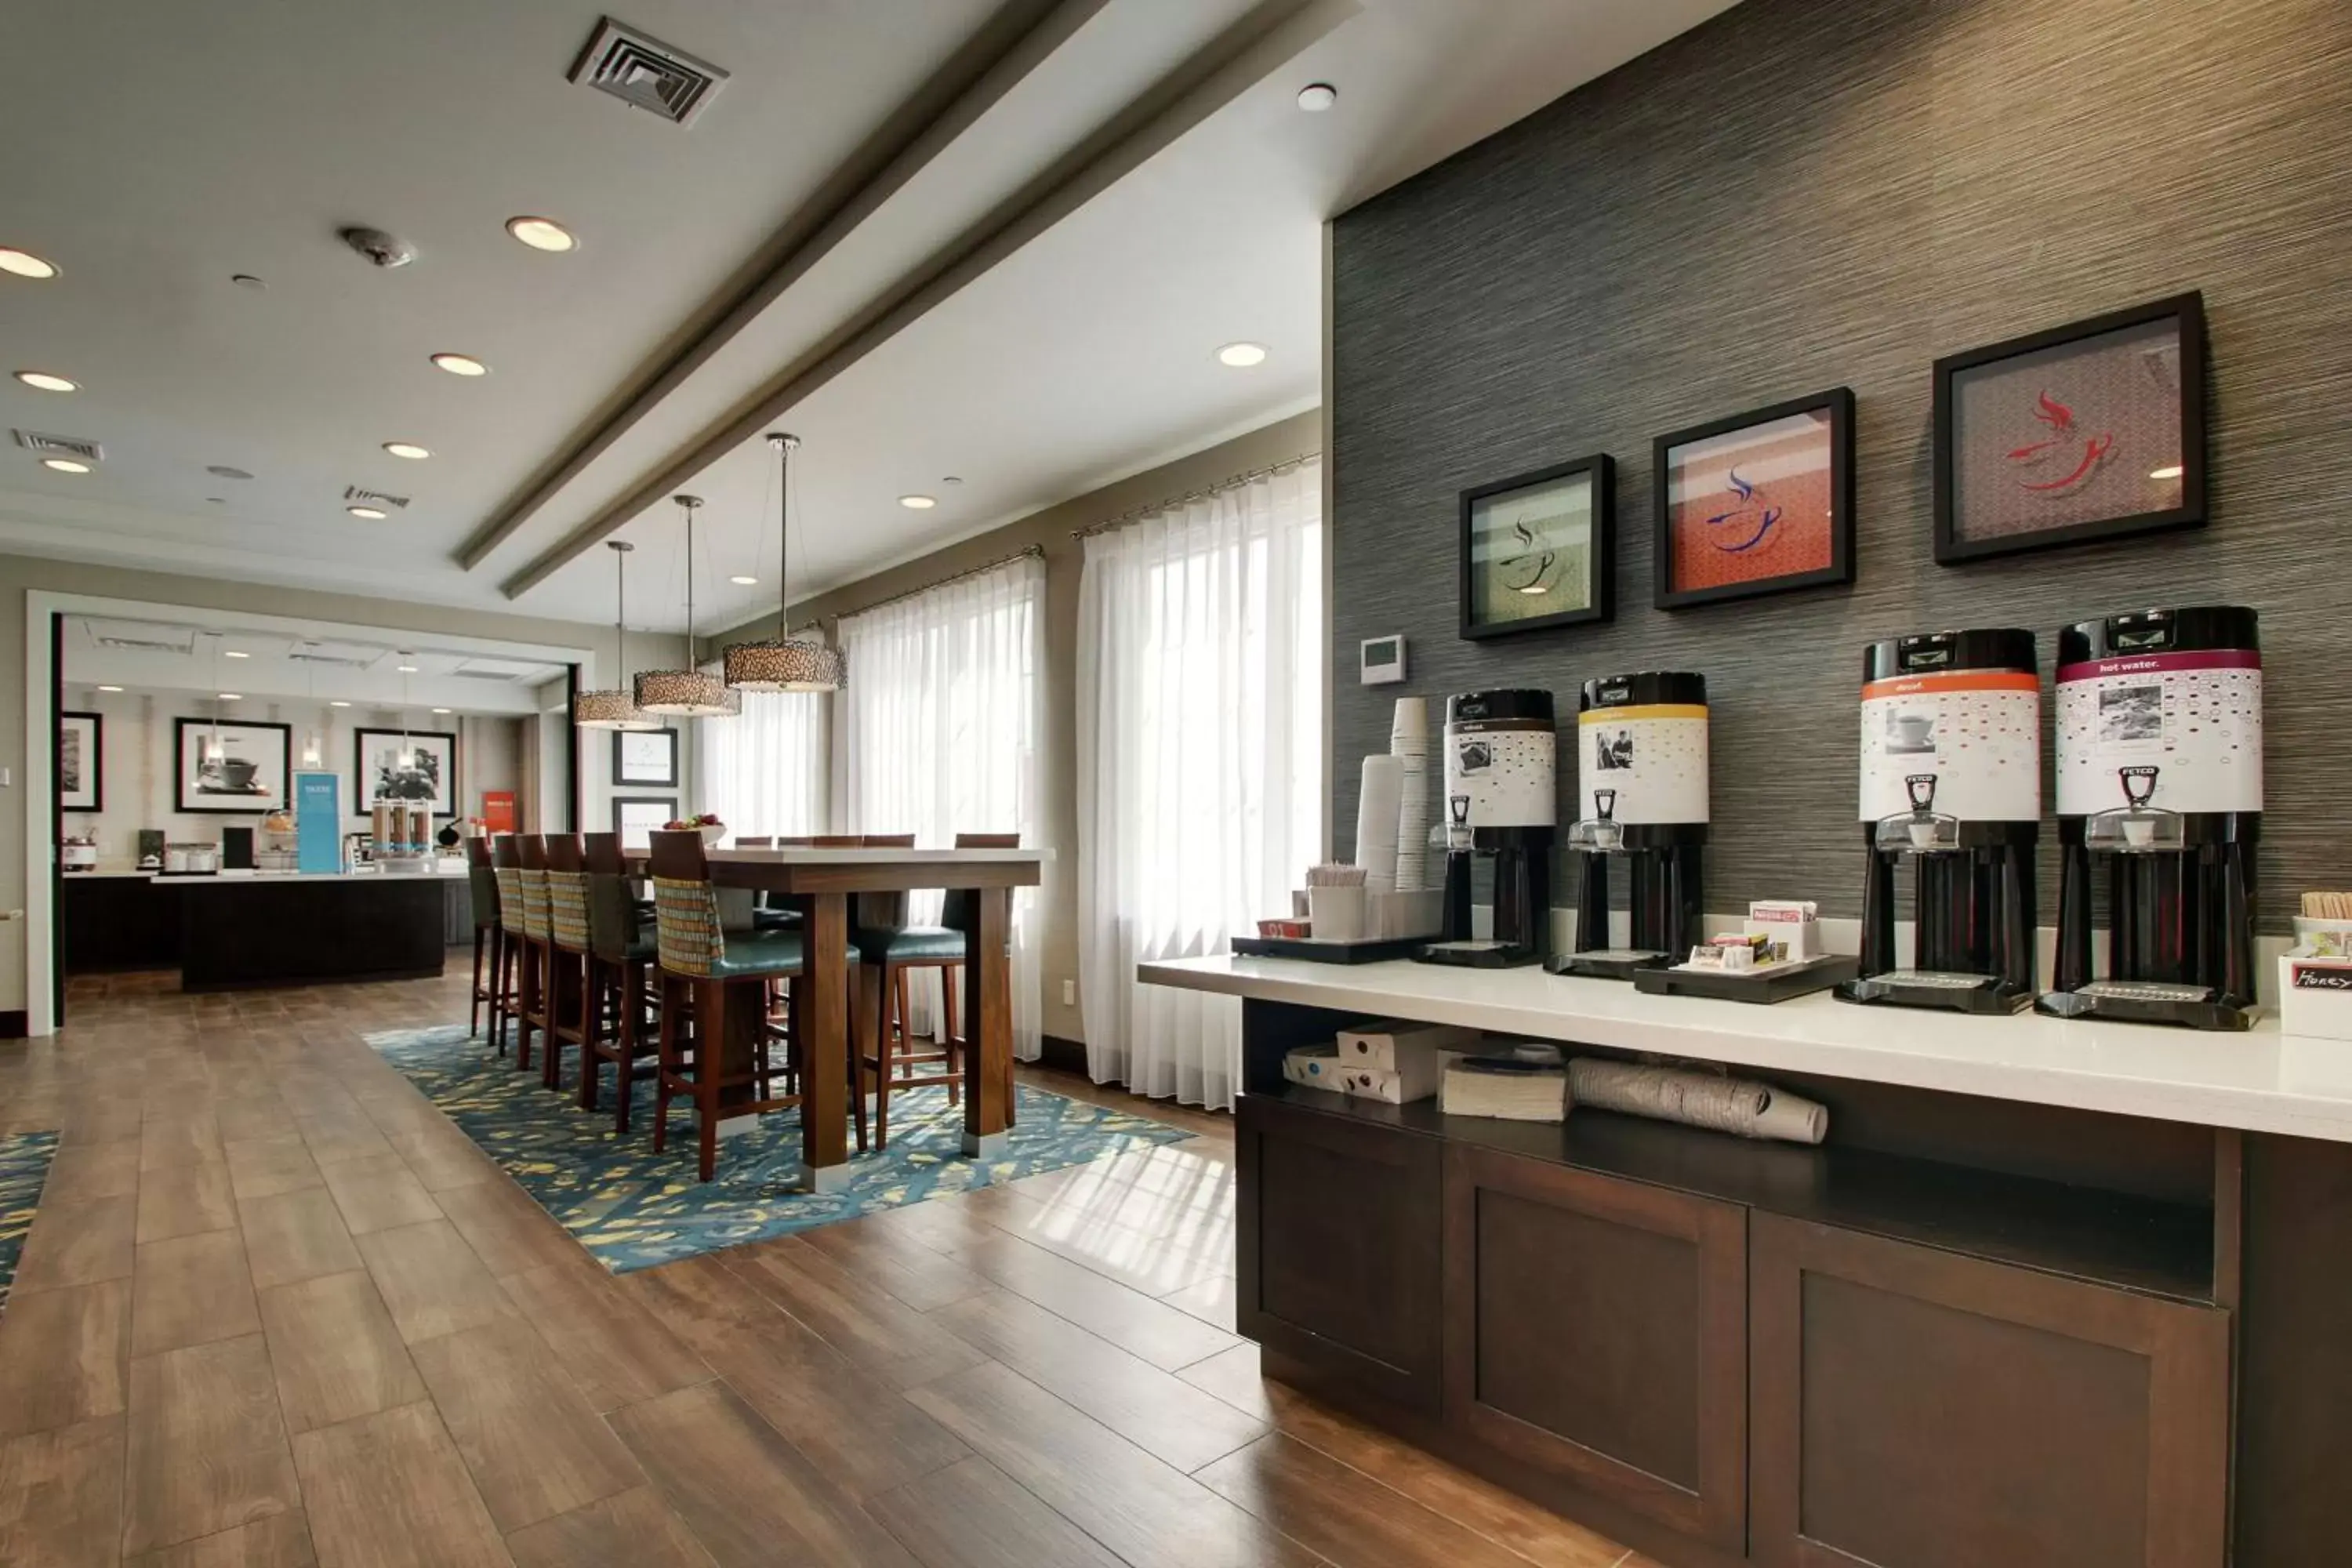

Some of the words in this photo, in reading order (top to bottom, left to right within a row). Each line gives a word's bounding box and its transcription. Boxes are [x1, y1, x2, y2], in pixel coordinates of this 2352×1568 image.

[2100, 663, 2120, 673] hot
[2122, 661, 2160, 670] water.
[2296, 969, 2352, 989] Honey
